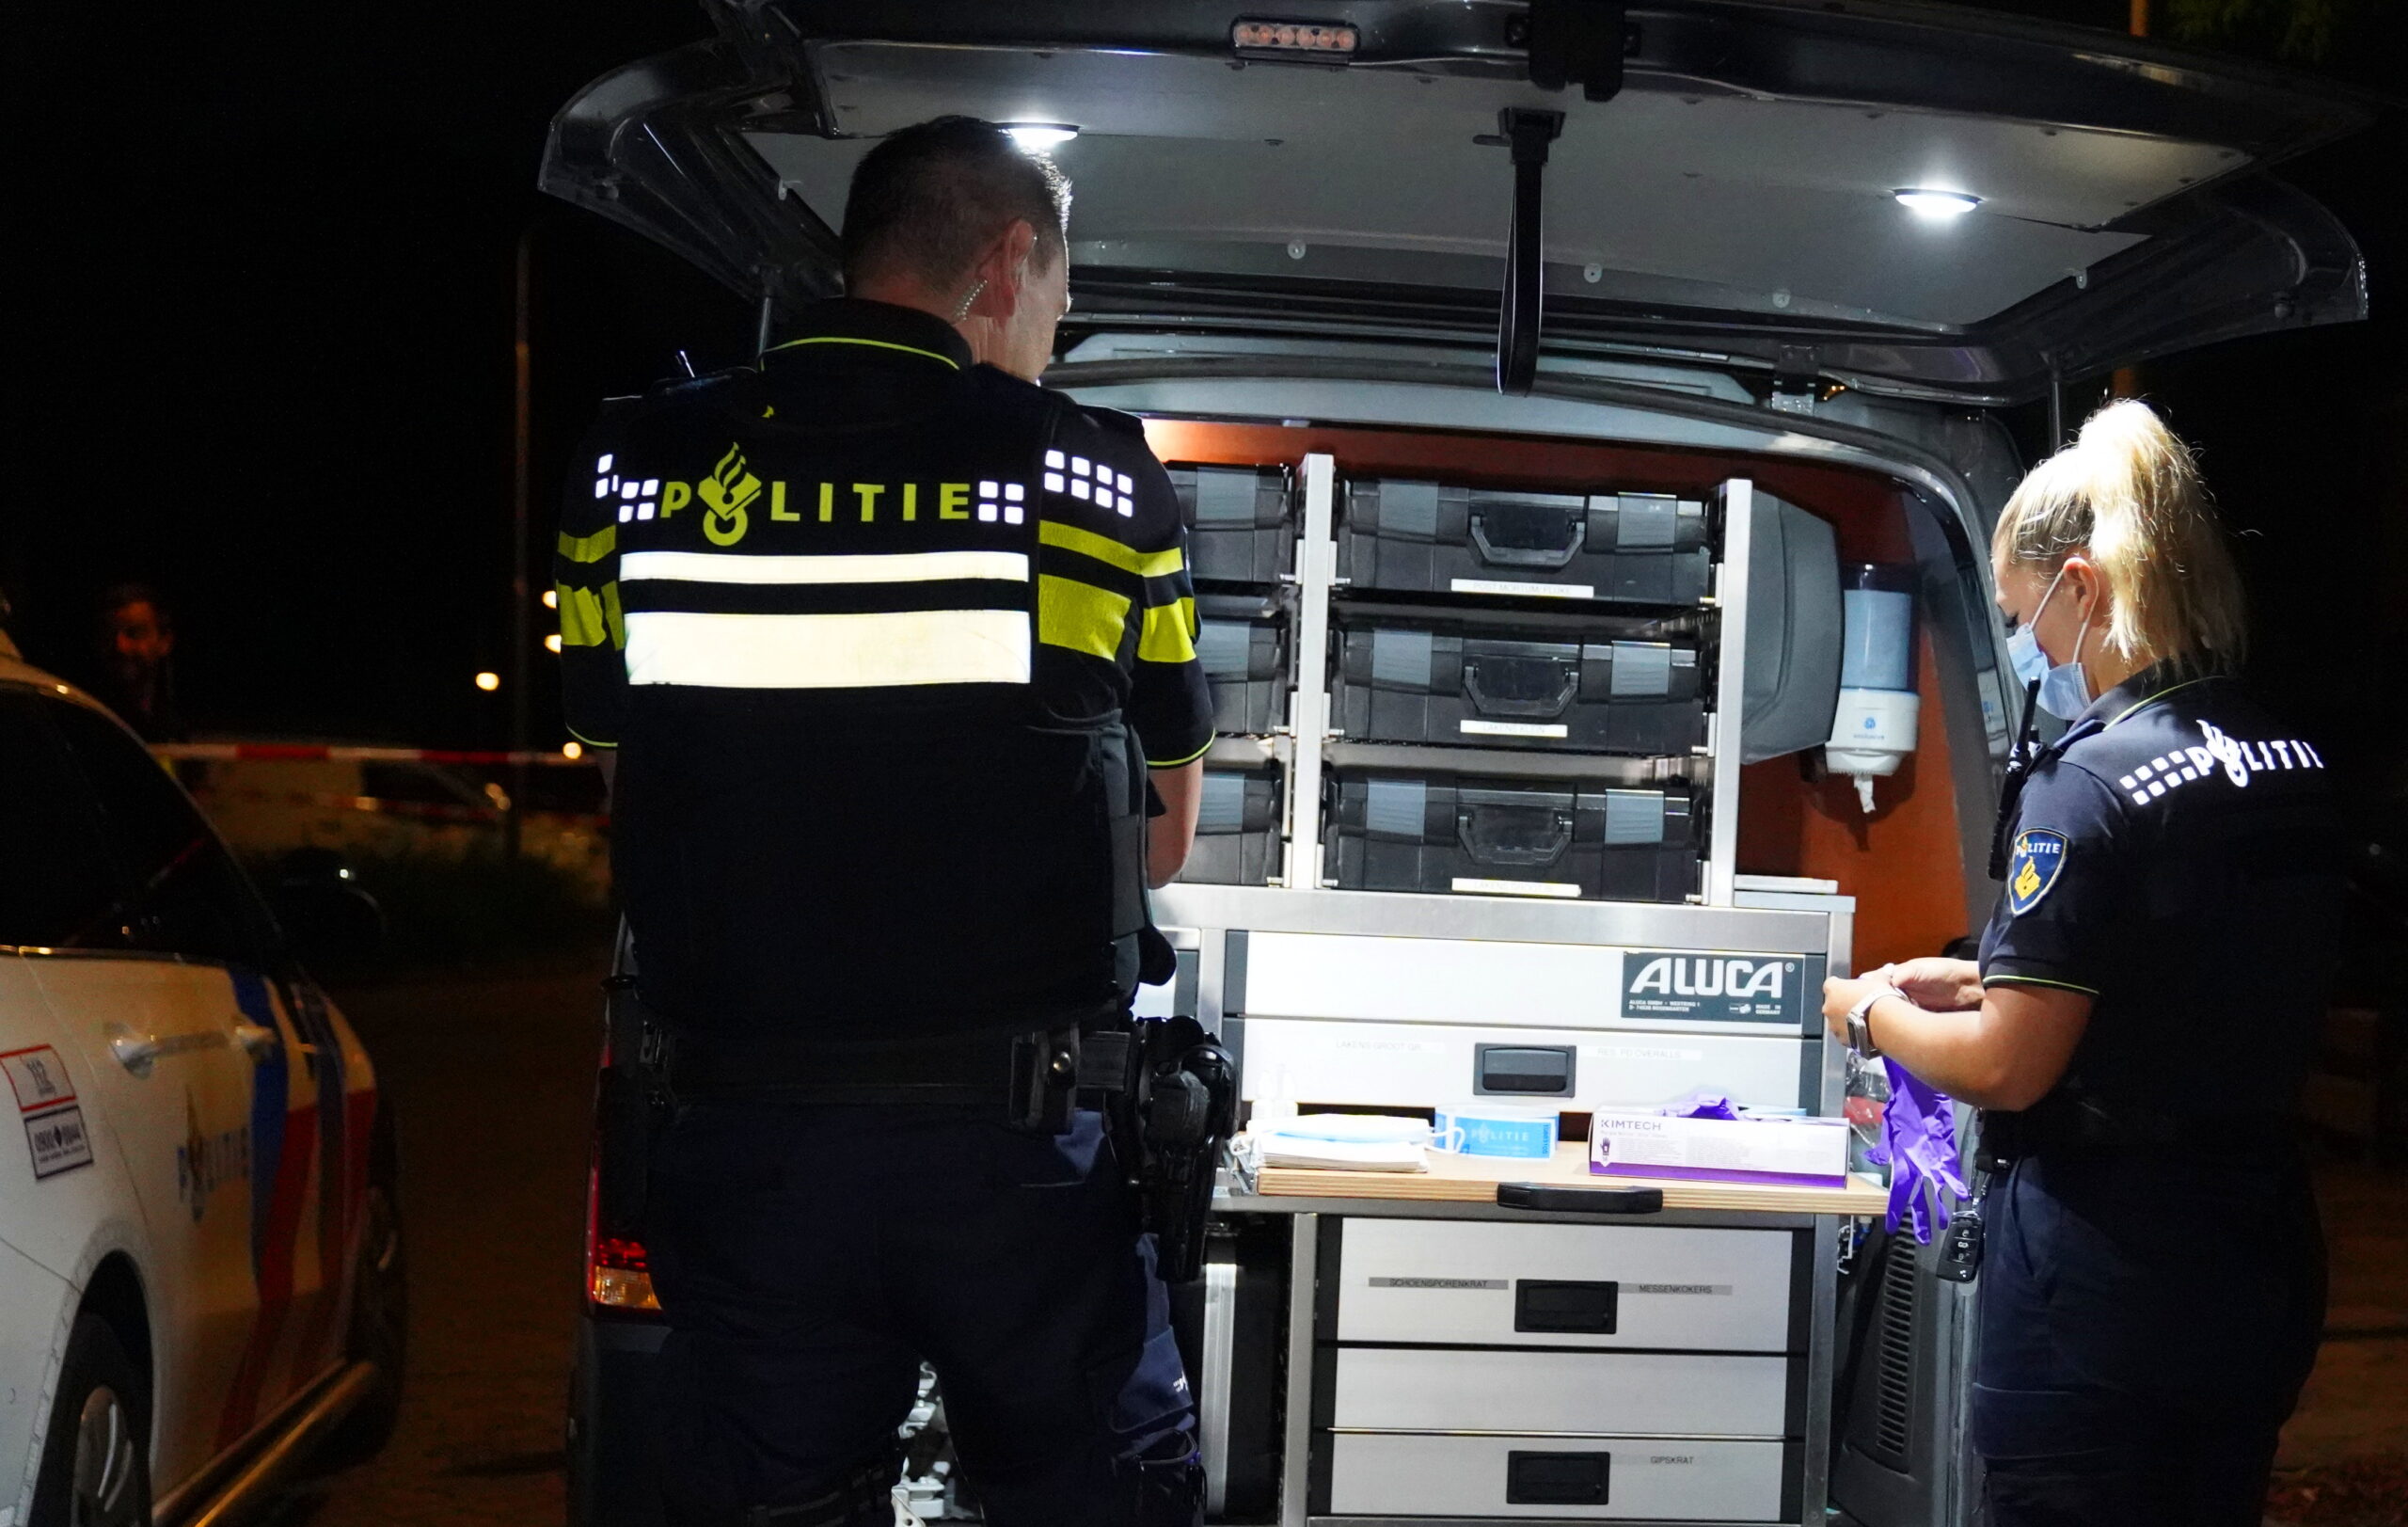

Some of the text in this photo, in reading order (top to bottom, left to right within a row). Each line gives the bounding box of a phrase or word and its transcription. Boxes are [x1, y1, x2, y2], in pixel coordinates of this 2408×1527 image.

[660, 463, 971, 547] POLITIE
[2185, 724, 2324, 787] POLITI
[1629, 958, 1783, 998] ALUCA
[1601, 1119, 1662, 1131] KIMTECH
[1650, 1455, 1694, 1465] GIPSKRAT
